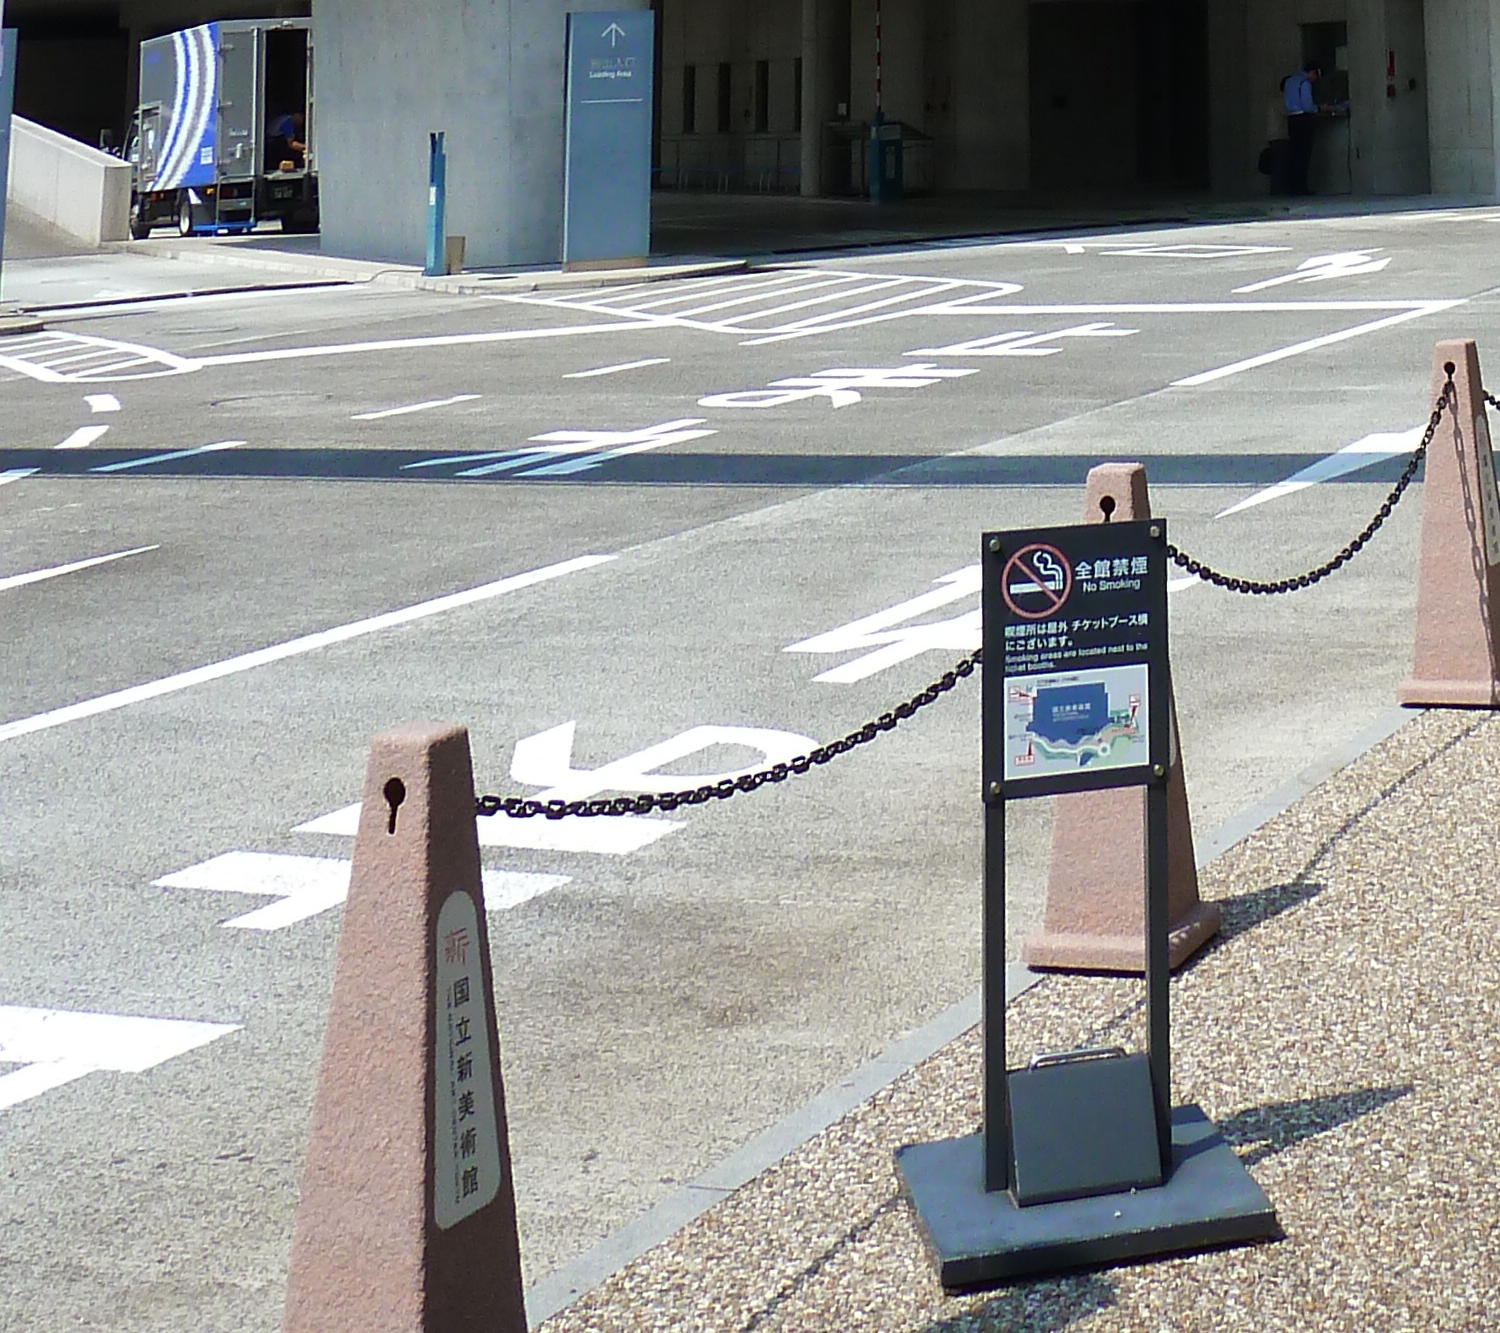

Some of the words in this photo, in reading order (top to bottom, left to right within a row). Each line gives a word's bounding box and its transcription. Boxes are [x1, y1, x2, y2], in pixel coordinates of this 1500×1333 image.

[1075, 556, 1149, 581] 全館禁煙
[1083, 581, 1097, 592] No
[1099, 578, 1141, 592] Smoking
[453, 975, 479, 1199] 国立新美術館
